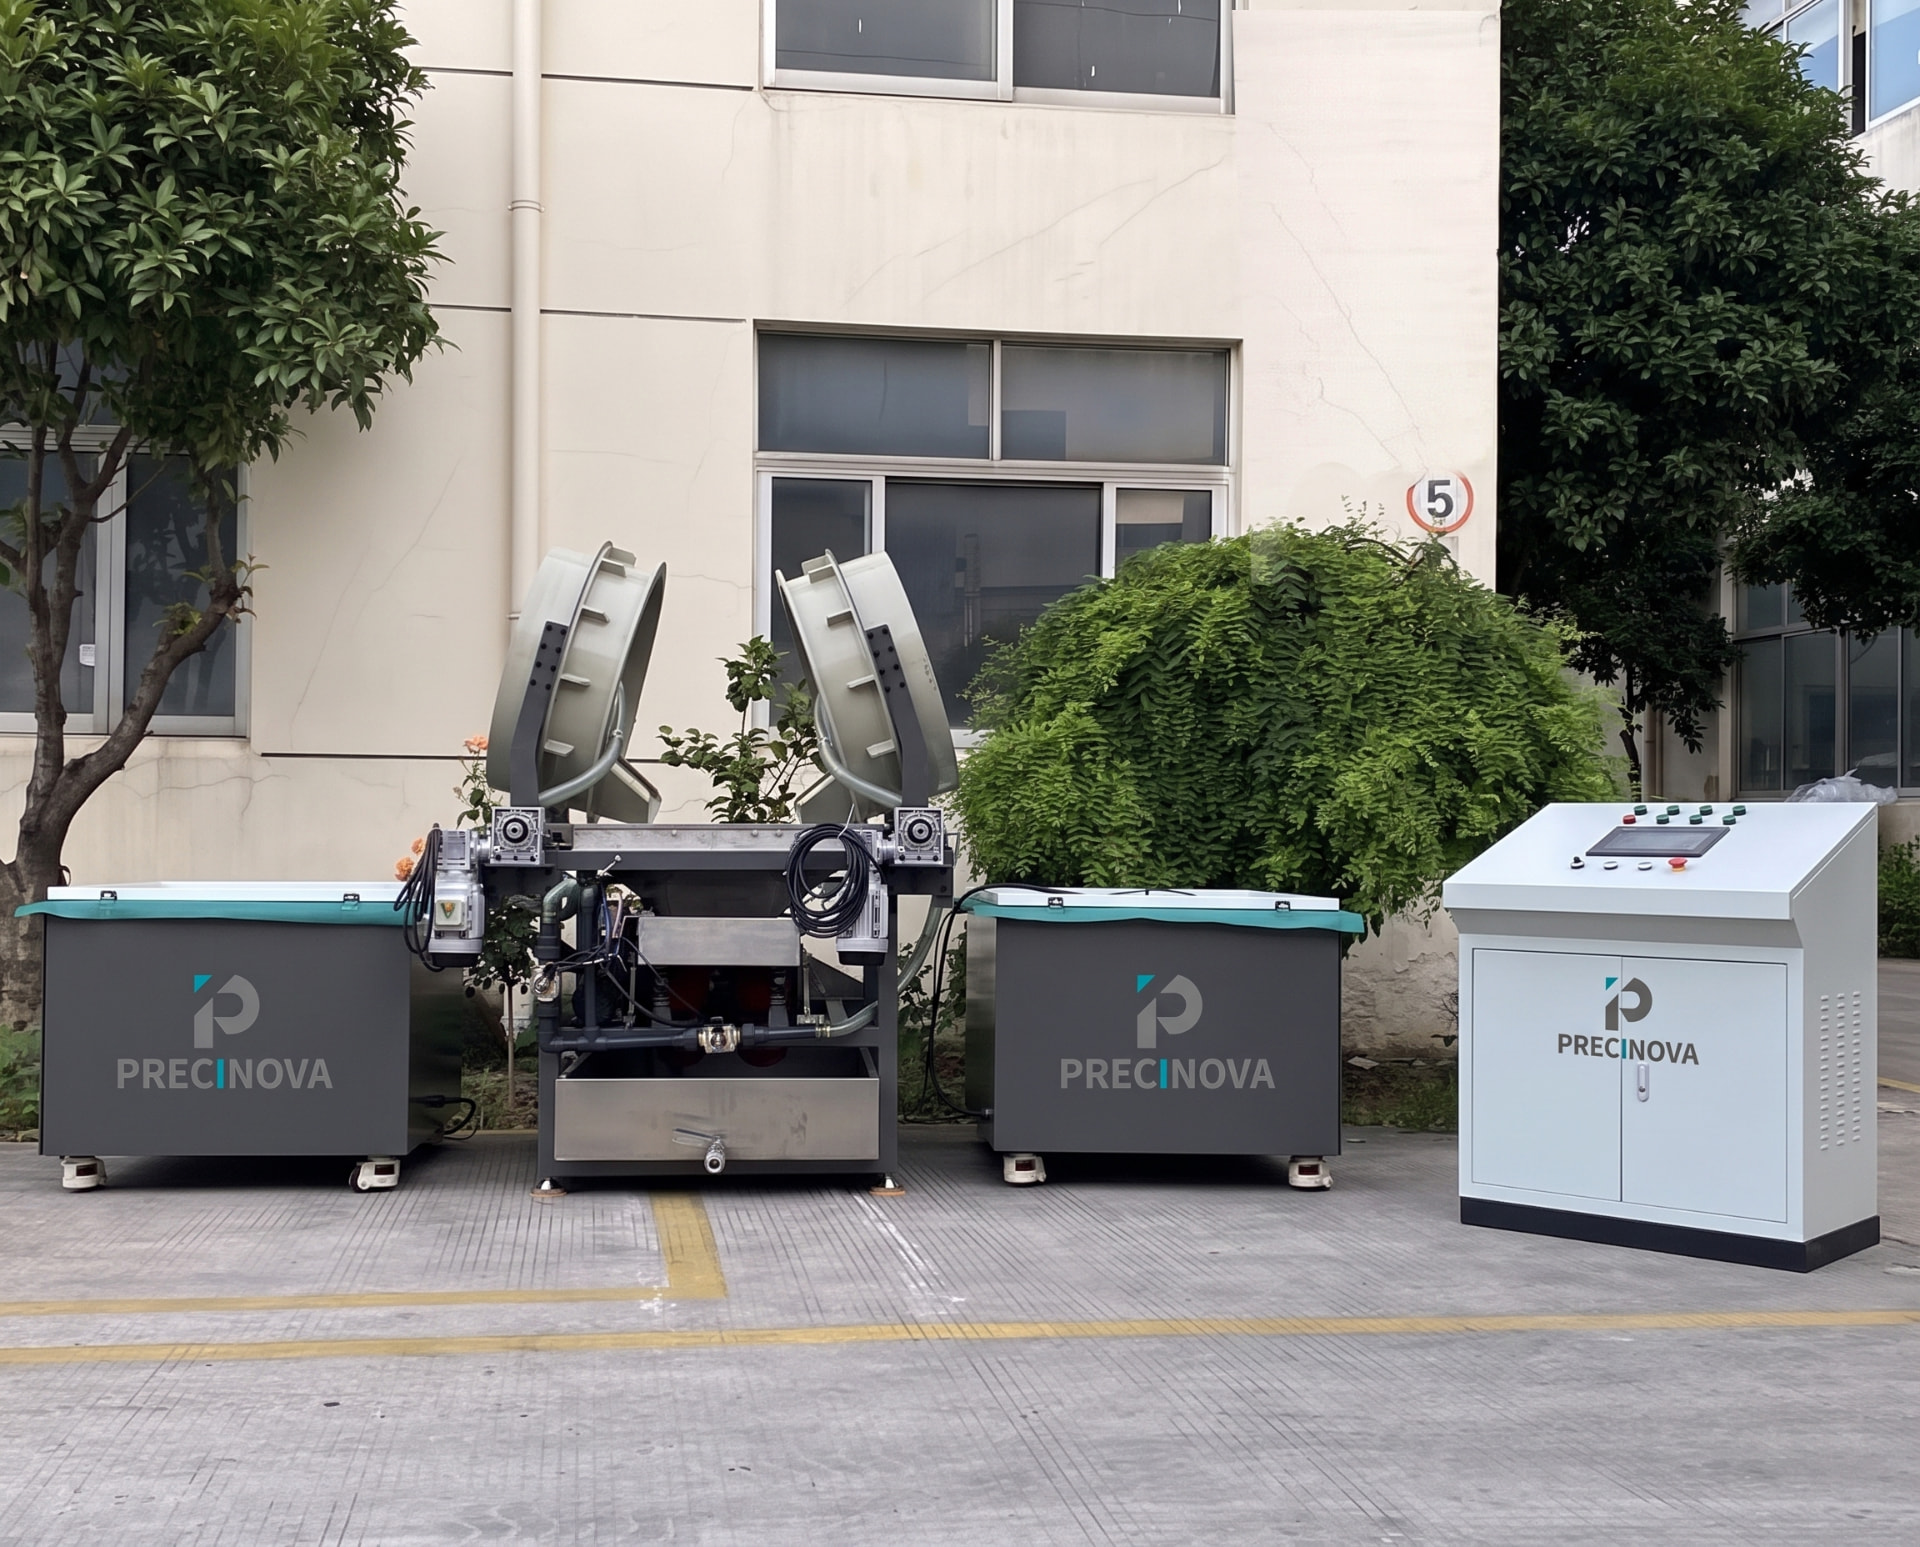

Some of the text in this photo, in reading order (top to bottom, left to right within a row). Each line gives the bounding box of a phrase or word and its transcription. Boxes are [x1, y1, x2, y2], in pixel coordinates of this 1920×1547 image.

[1427, 479, 1454, 518] 5
[1557, 1032, 1700, 1066] PRECINOVA
[117, 1058, 333, 1090] PRECINOVA
[1060, 1058, 1276, 1090] PRECINOVA
